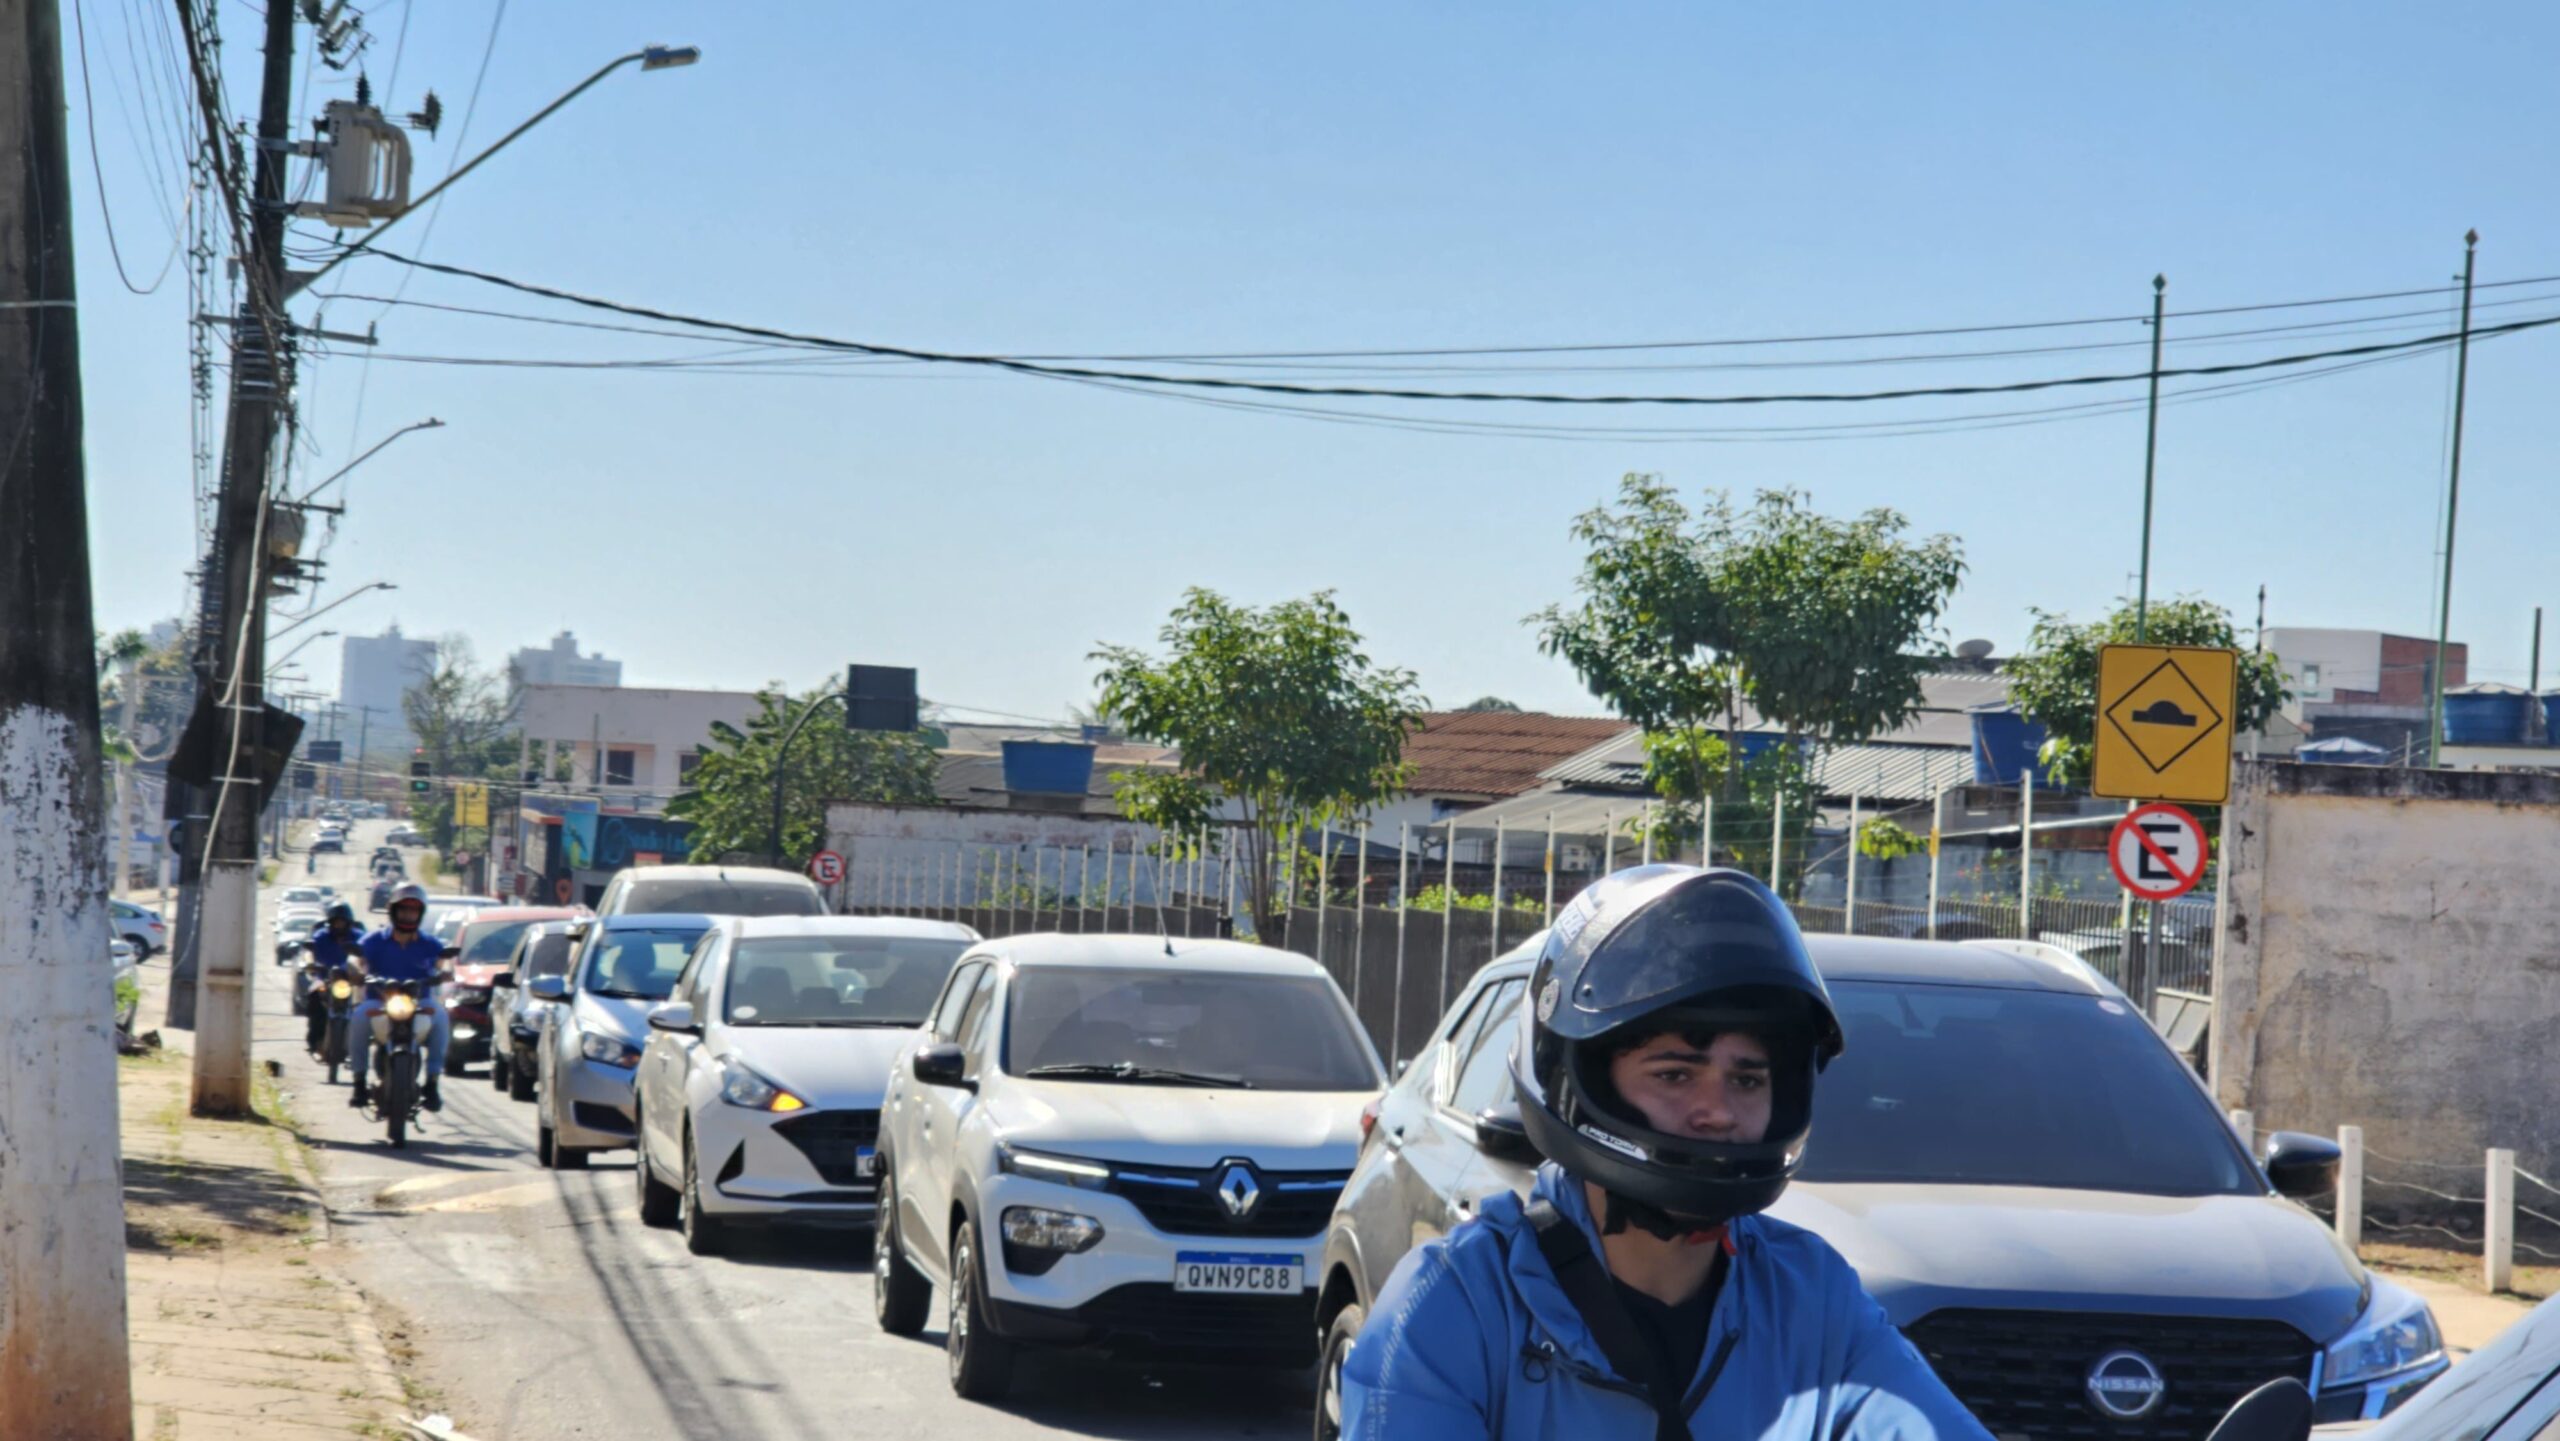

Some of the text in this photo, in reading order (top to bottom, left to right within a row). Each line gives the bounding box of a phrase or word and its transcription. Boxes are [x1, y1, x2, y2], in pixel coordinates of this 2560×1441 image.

[2139, 824, 2181, 880] E
[822, 858, 837, 878] E
[1188, 1264, 1290, 1290] QWN9C88
[2088, 1377, 2164, 1392] NISSAN
